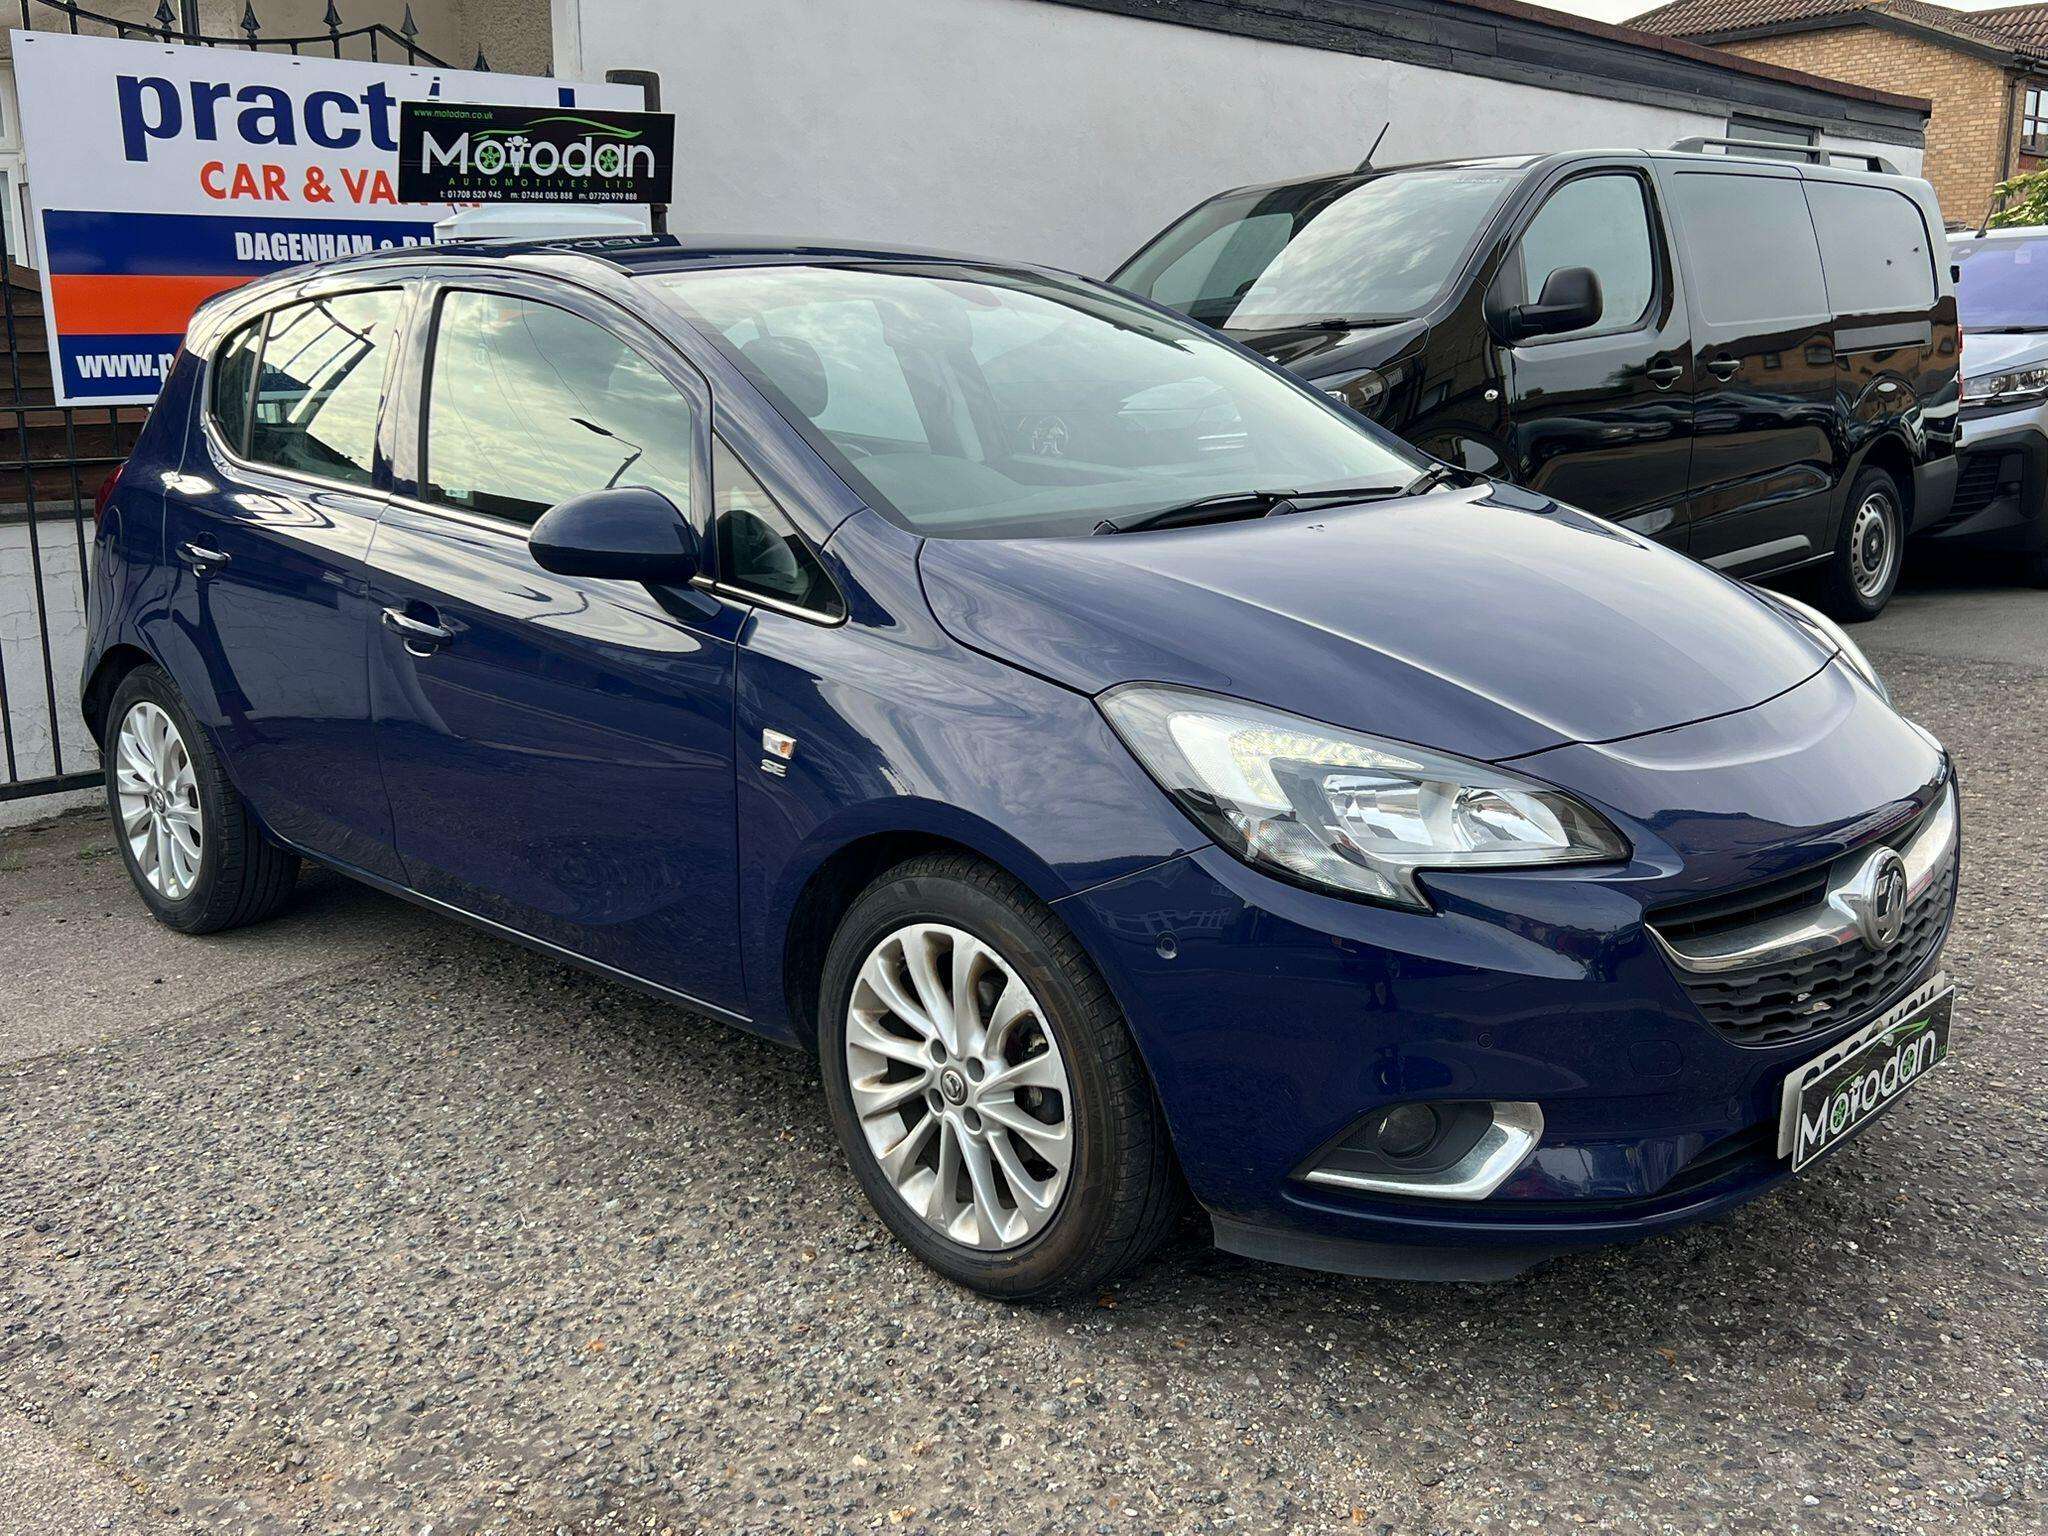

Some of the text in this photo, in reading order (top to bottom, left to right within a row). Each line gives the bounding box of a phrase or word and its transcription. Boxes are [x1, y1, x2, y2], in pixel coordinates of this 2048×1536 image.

[116, 75, 576, 162] pract
[413, 109, 494, 119] www.motodan.co.uk
[422, 130, 655, 178] Motodan
[200, 161, 428, 206] CAR & VA
[447, 190, 471, 198] 01708
[472, 190, 487, 199] 520
[488, 190, 502, 199] 945
[521, 191, 543, 199] 07484
[545, 191, 559, 199] 085
[589, 192, 610, 200] 07720
[448, 177, 635, 189] AUTOMOTIVES LTD
[235, 231, 373, 262] DAGENHAM
[1797, 1029, 1936, 1163] Motodan
